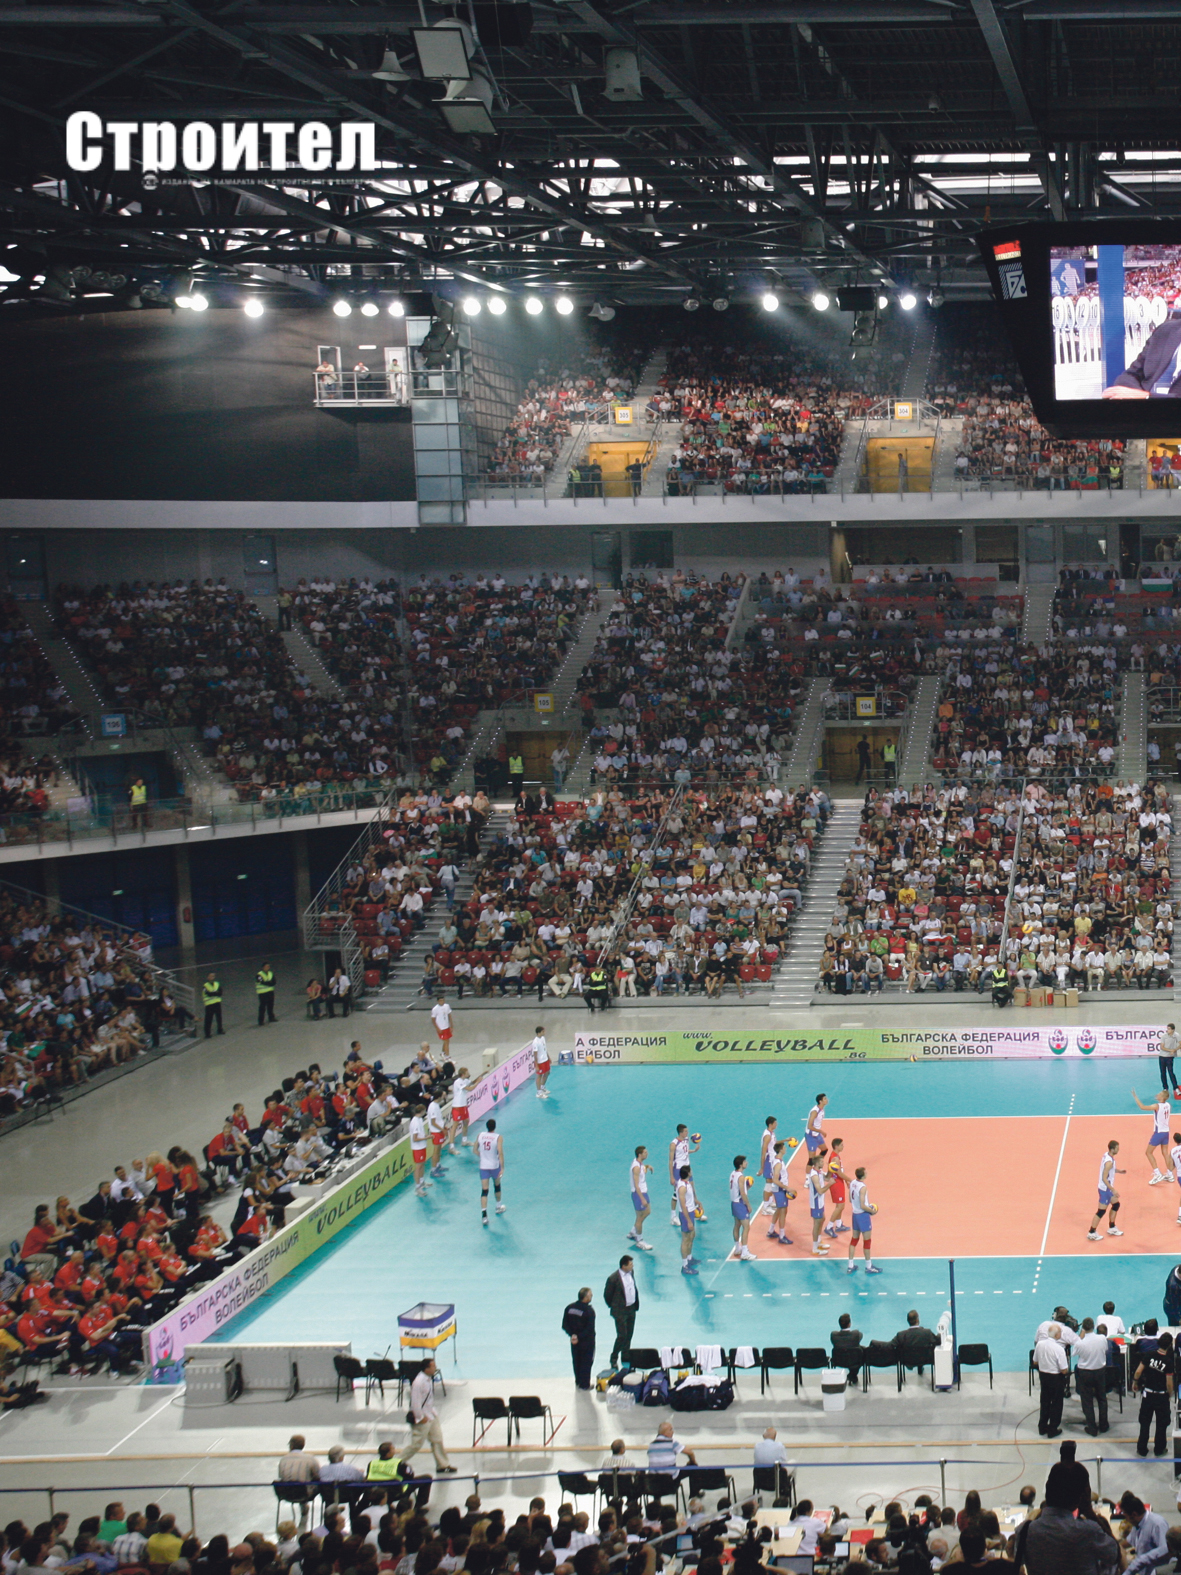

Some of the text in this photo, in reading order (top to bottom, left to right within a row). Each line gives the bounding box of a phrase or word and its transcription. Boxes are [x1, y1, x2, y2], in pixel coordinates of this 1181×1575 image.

[588, 1036, 667, 1047] ФЕДЕРАЦИЯ
[682, 1032, 713, 1040] www.
[881, 1033, 957, 1043] БЪЛГАРСКА
[961, 1032, 1040, 1043] ФЕДЕРАЦИЯ
[695, 1039, 856, 1053] VOLLEYBALL
[923, 1044, 993, 1055] ВОЛЕЙБОЛ
[317, 1153, 407, 1234] VOLLEYBALL
[180, 1230, 299, 1331] БЪЛГАРСКА ФЕДЕРАЦИЯ
[215, 1272, 269, 1325] ВОЛЕЙБОЛ
